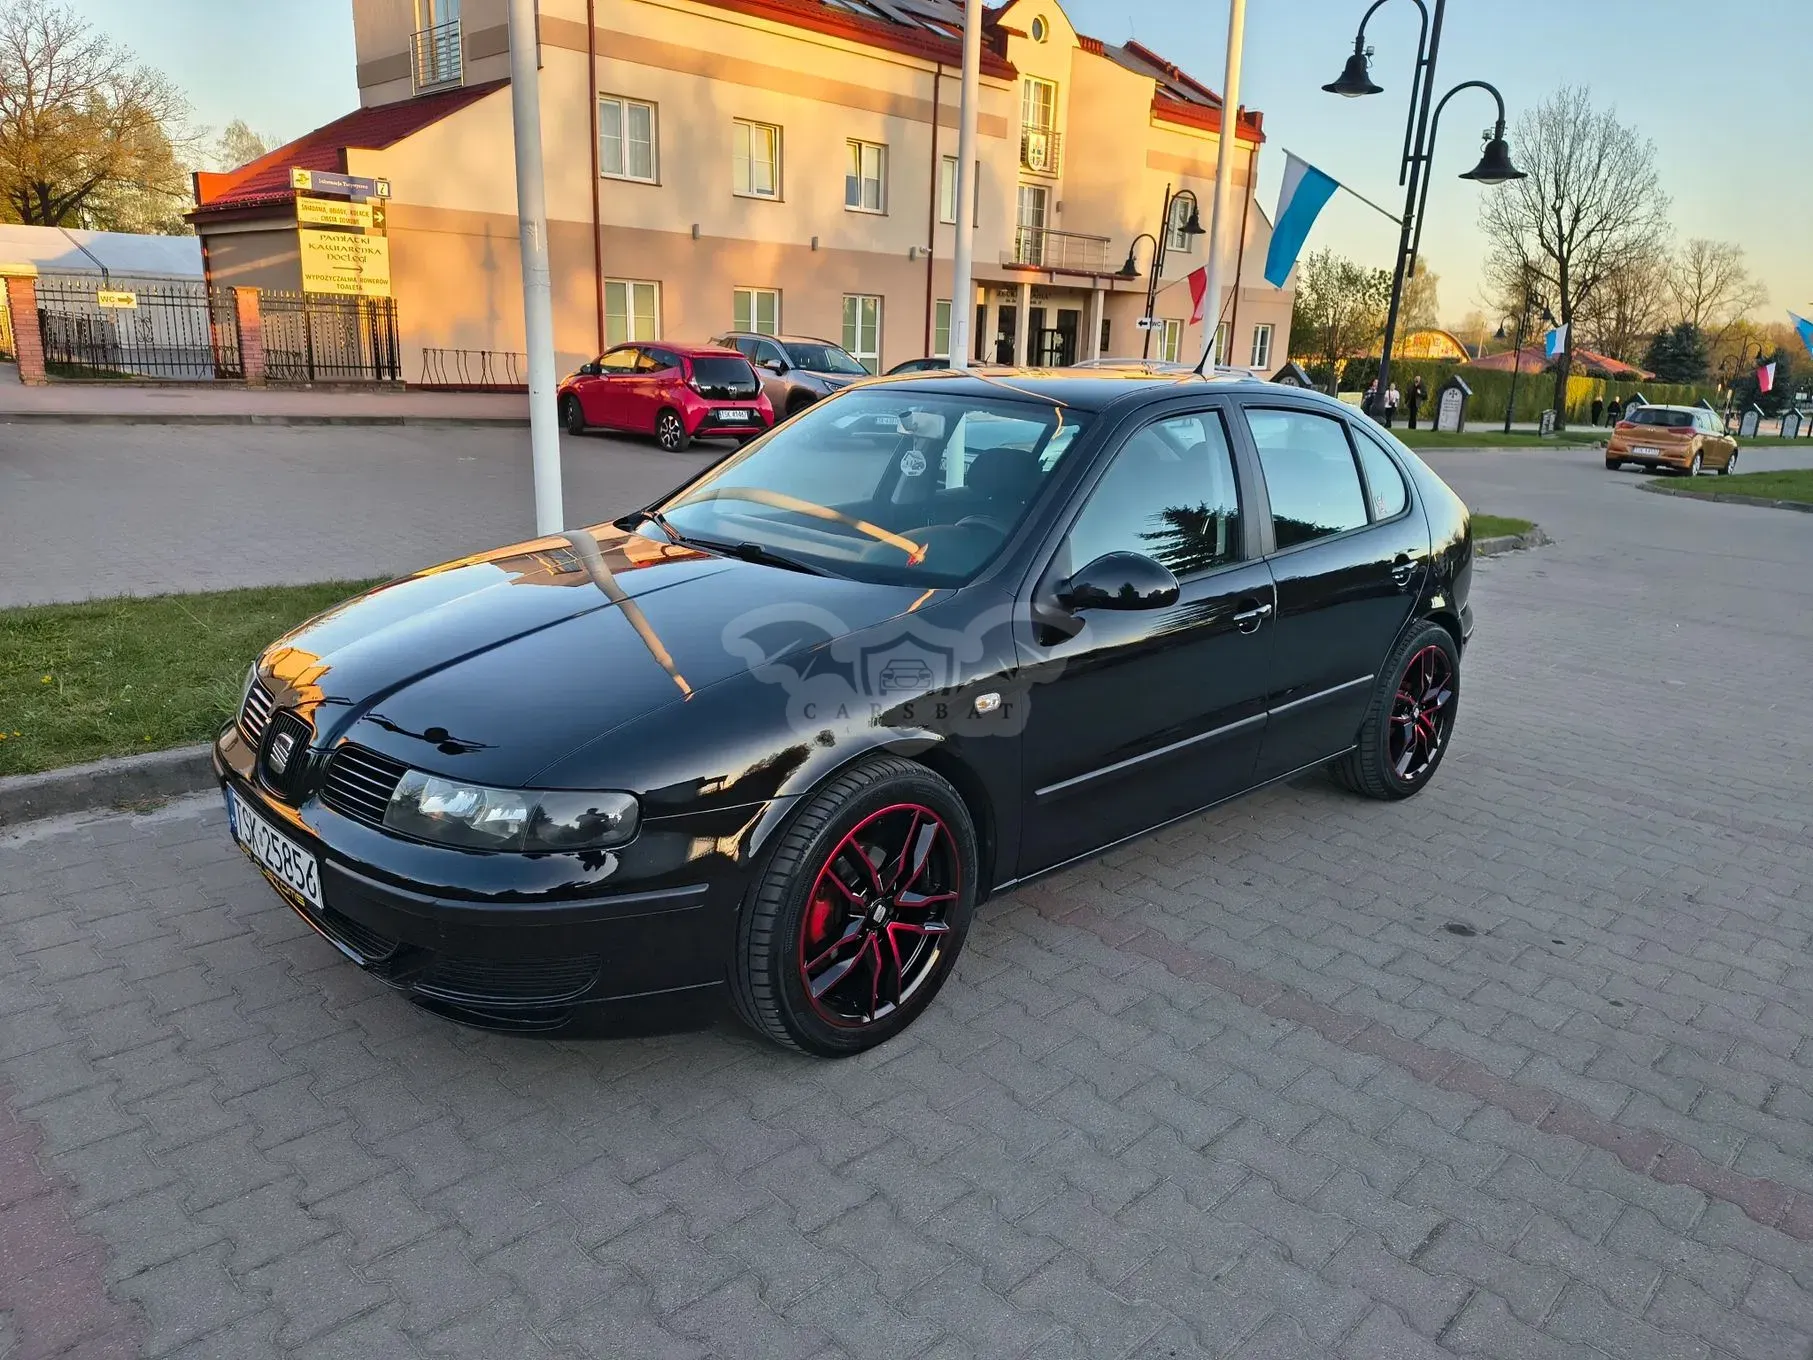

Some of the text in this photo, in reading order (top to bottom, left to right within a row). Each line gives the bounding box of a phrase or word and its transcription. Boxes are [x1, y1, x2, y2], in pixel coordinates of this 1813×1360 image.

[308, 242, 382, 255] KAWIARENKA
[336, 283, 363, 291] TOALETA
[100, 295, 115, 303] WC
[234, 798, 318, 899] TSK 25856
